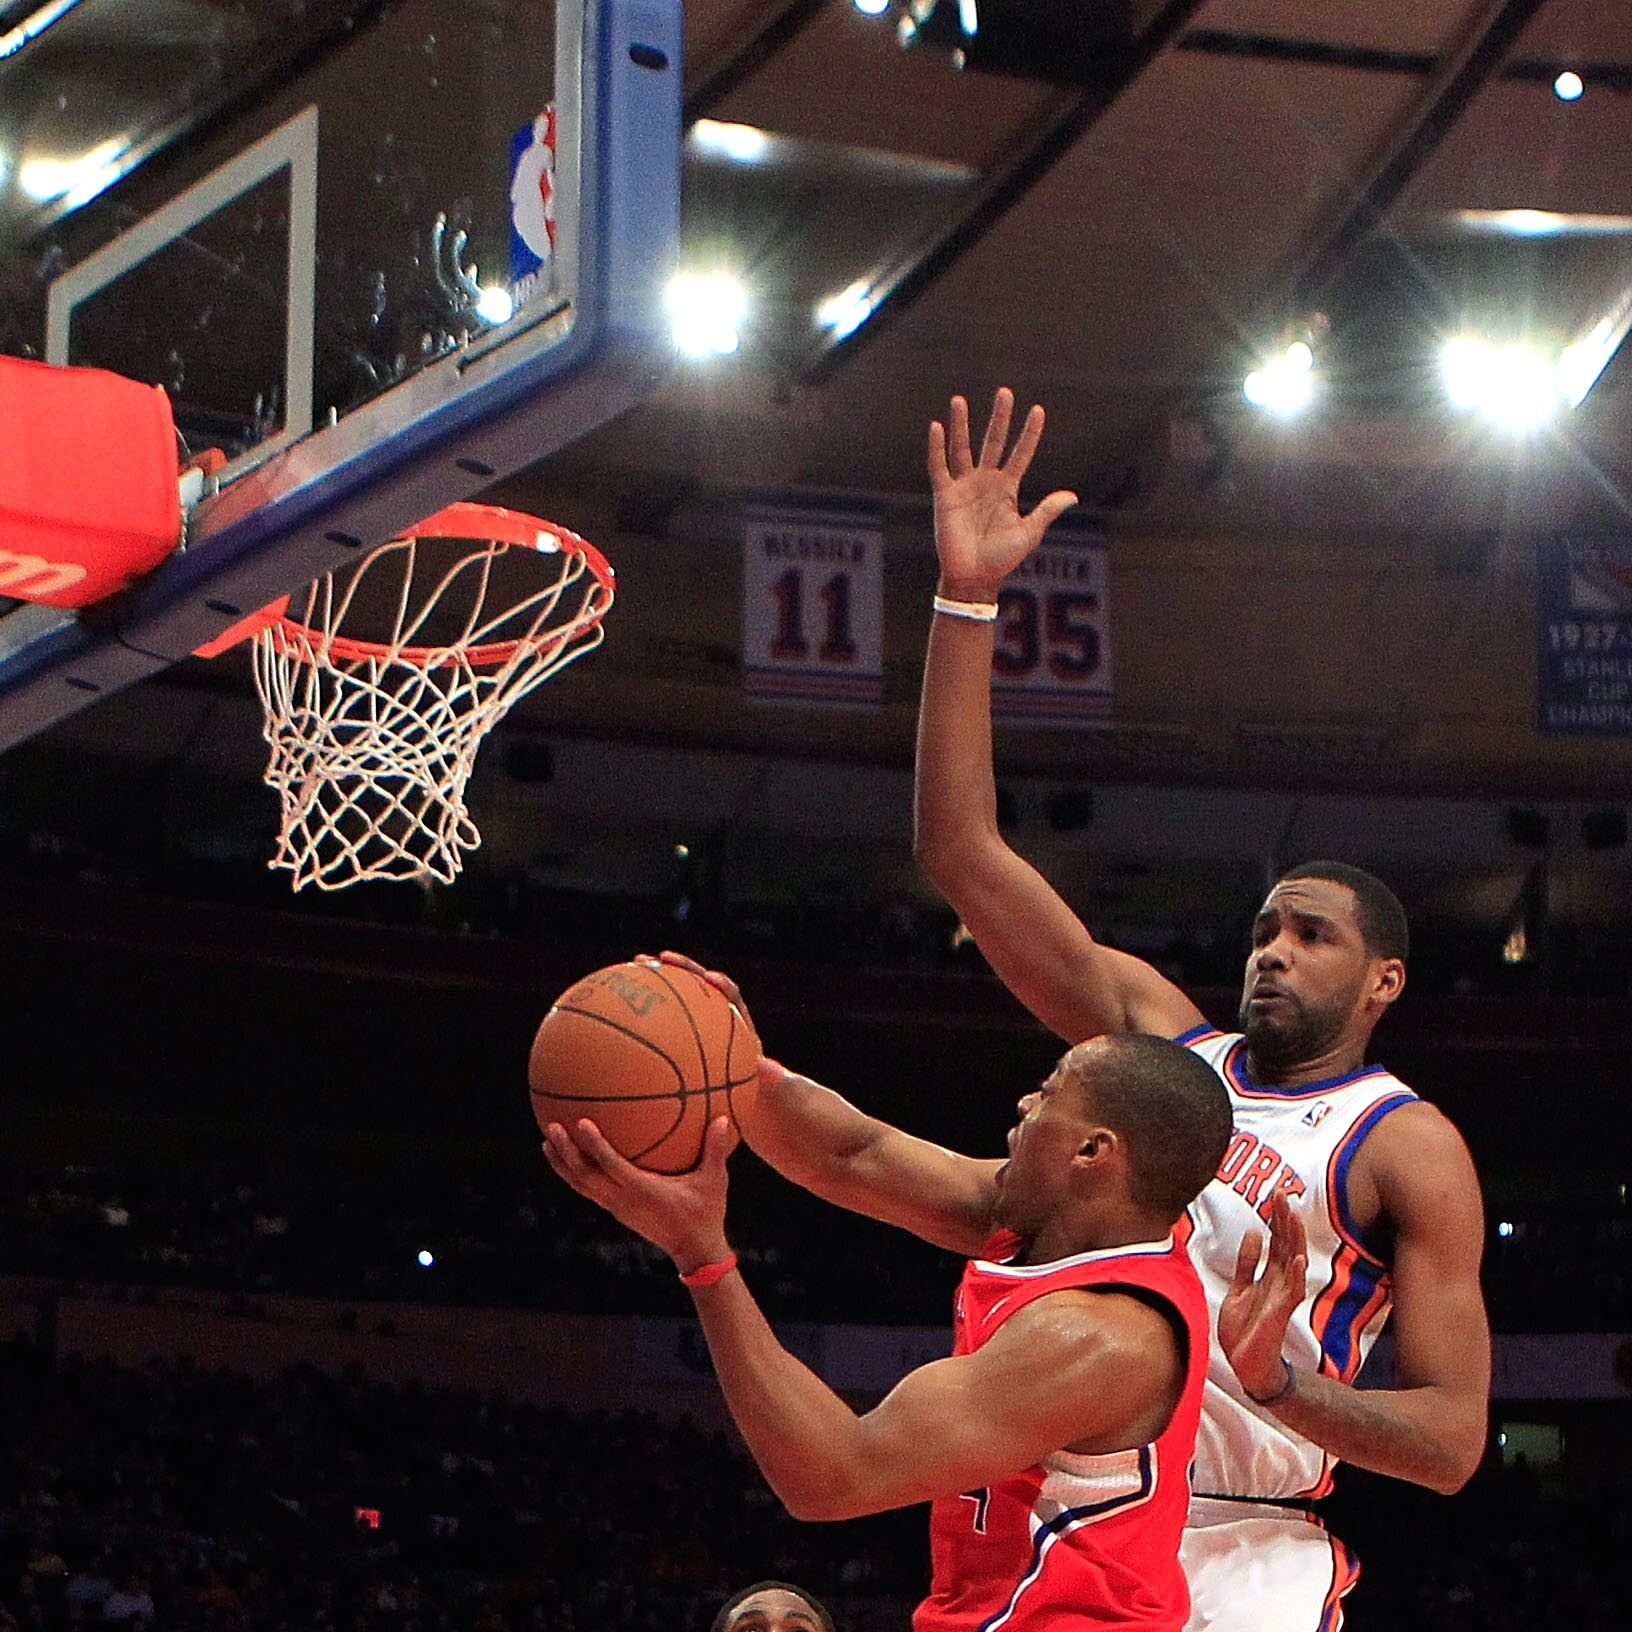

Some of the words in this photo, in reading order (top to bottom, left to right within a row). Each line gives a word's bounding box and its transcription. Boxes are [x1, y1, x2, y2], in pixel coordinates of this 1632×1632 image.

[770, 567, 858, 665] 11
[992, 588, 1101, 682] 35
[1215, 1127, 1307, 1225] ORK
